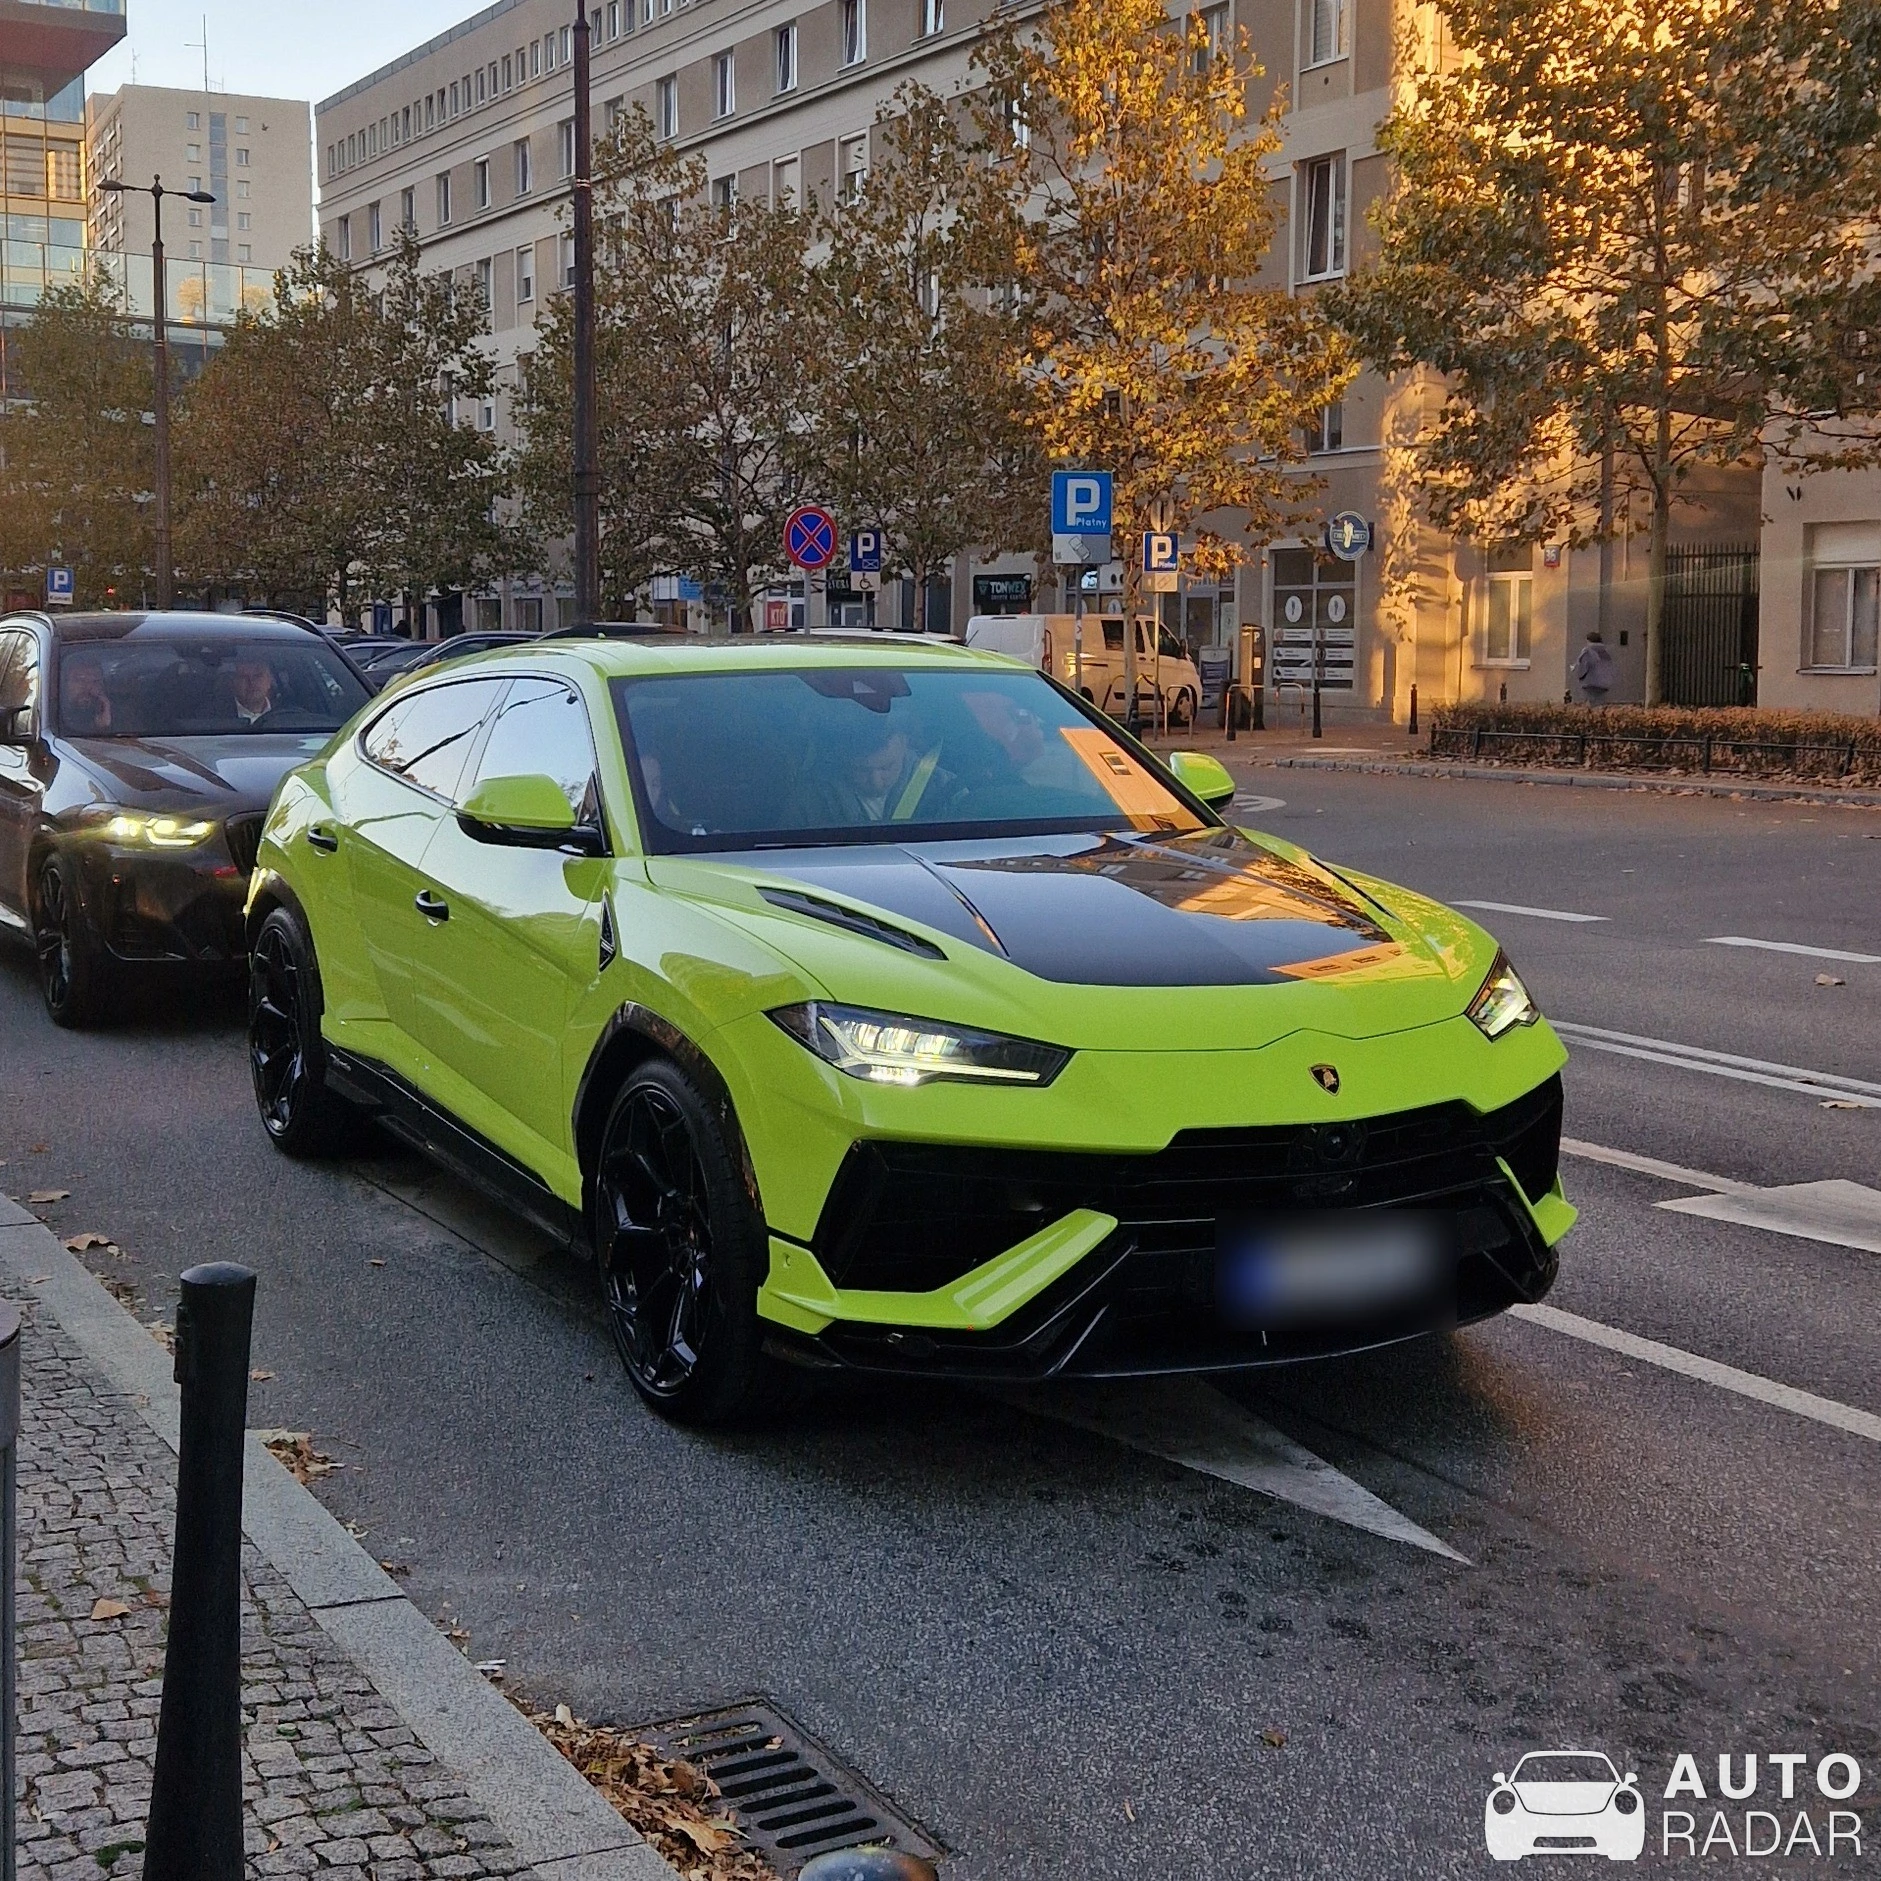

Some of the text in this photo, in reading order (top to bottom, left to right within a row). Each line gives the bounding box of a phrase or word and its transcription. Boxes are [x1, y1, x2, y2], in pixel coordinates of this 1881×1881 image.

[1067, 479, 1100, 526] P
[1076, 517, 1107, 529] Płatny
[858, 532, 875, 559] P
[1151, 536, 1172, 568] P
[54, 570, 69, 590] P
